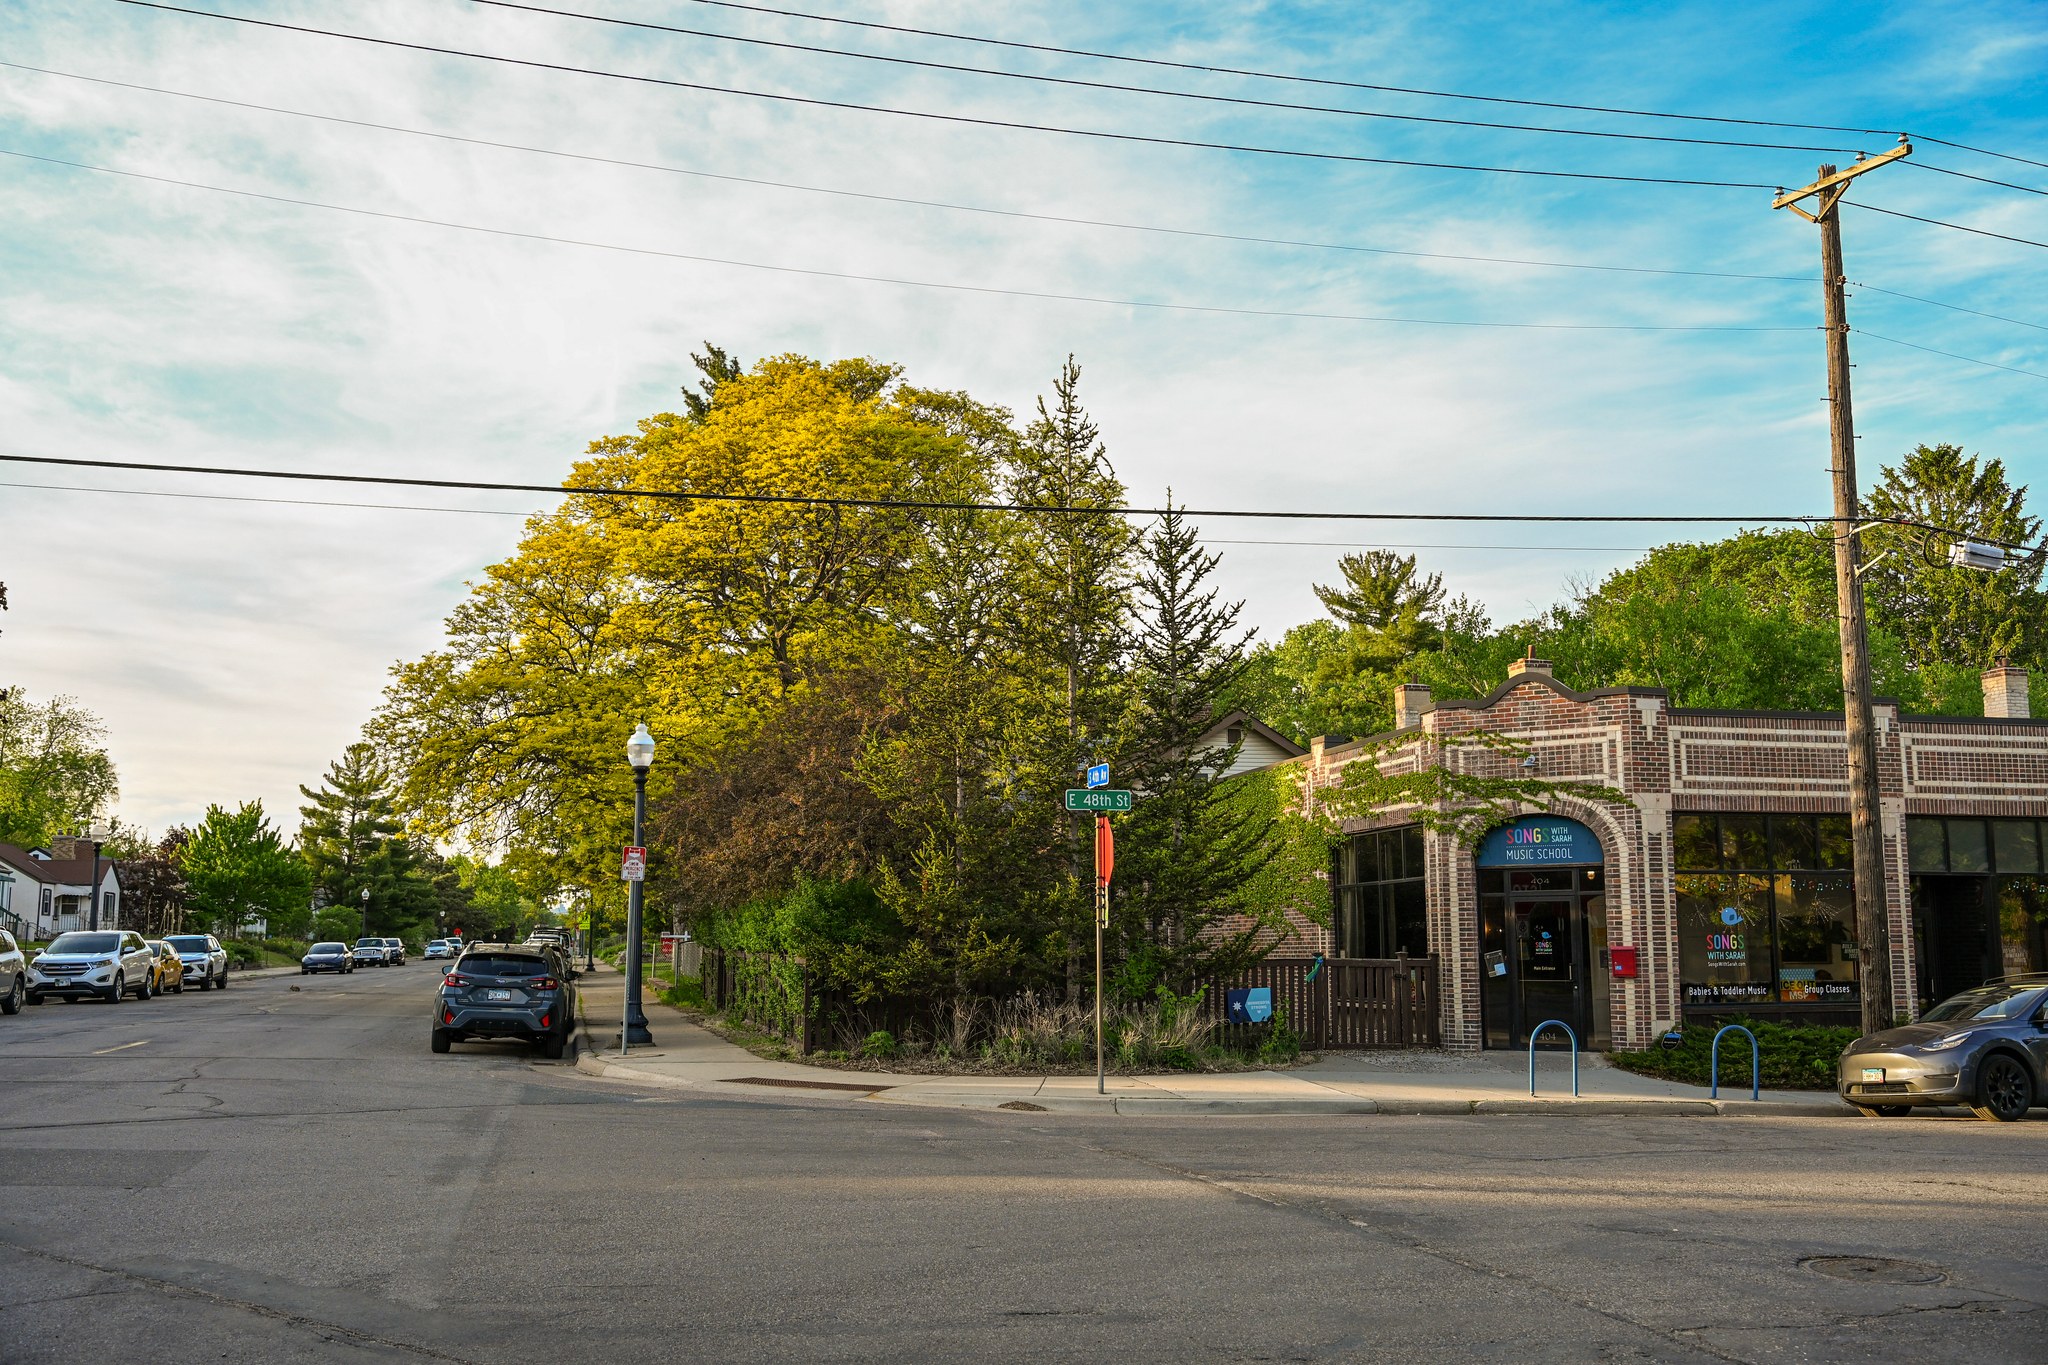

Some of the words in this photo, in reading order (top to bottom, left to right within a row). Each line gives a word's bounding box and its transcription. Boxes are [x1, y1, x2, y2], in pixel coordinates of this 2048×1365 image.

[1069, 793, 1076, 806] E
[1083, 793, 1112, 807] 48th
[1116, 794, 1129, 807] St
[1505, 827, 1550, 845] SONGS
[1551, 826, 1568, 835] WITH
[1551, 834, 1573, 843] SARAH
[1506, 848, 1534, 860] MUSIC
[1537, 847, 1573, 860] SCHOOL
[1530, 877, 1550, 885] 404
[1535, 941, 1553, 949] SONGS
[1706, 934, 1745, 950] SONGS
[1707, 951, 1725, 960] WITH
[1725, 951, 1746, 960] SARAH
[1688, 986, 1712, 996] Babies
[1713, 986, 1719, 995] &
[1720, 985, 1746, 995] Toddler
[1747, 985, 1767, 995] Music
[1780, 980, 1796, 991] ICE
[1804, 984, 1824, 996] Group
[1825, 984, 1850, 994] Classes
[1789, 990, 1809, 1000] MSP
[1539, 1032, 1556, 1041] 404
